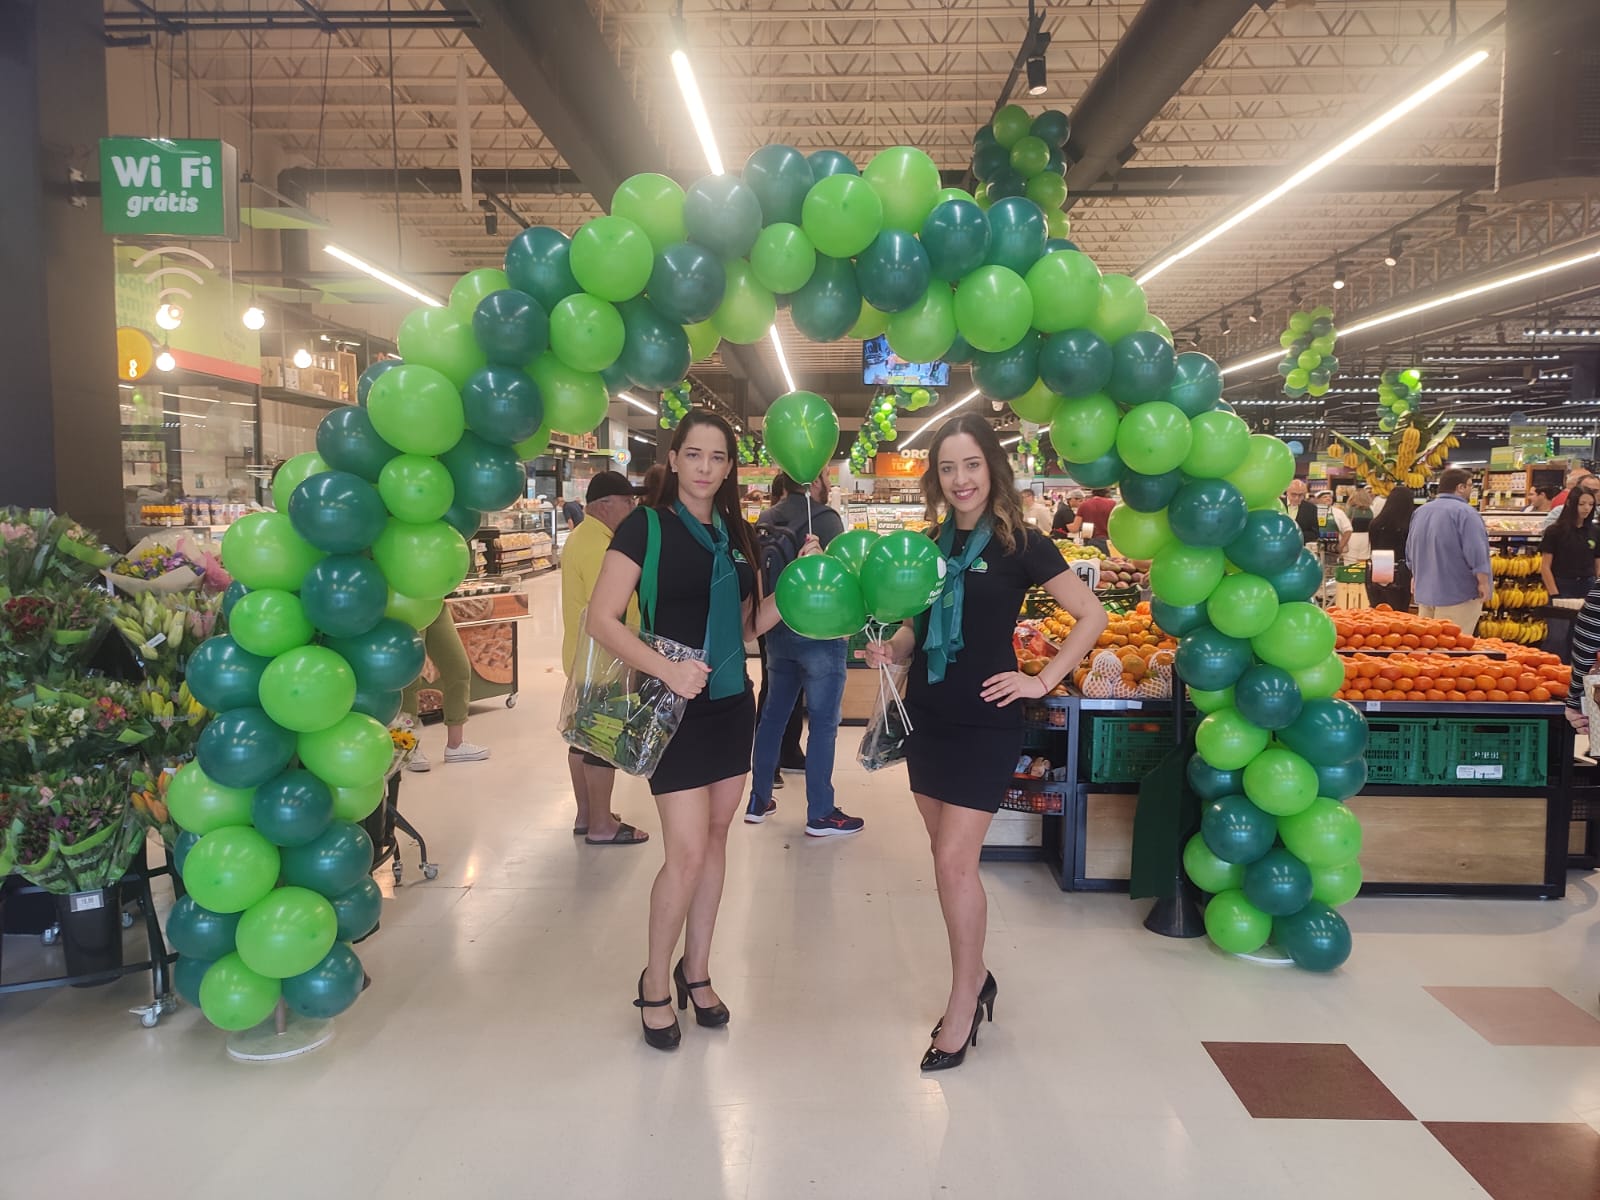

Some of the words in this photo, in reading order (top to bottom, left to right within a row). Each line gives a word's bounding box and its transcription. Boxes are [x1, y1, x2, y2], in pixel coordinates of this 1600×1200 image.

[111, 154, 162, 188] Wi
[181, 155, 213, 189] Fi
[126, 189, 199, 218] grátis
